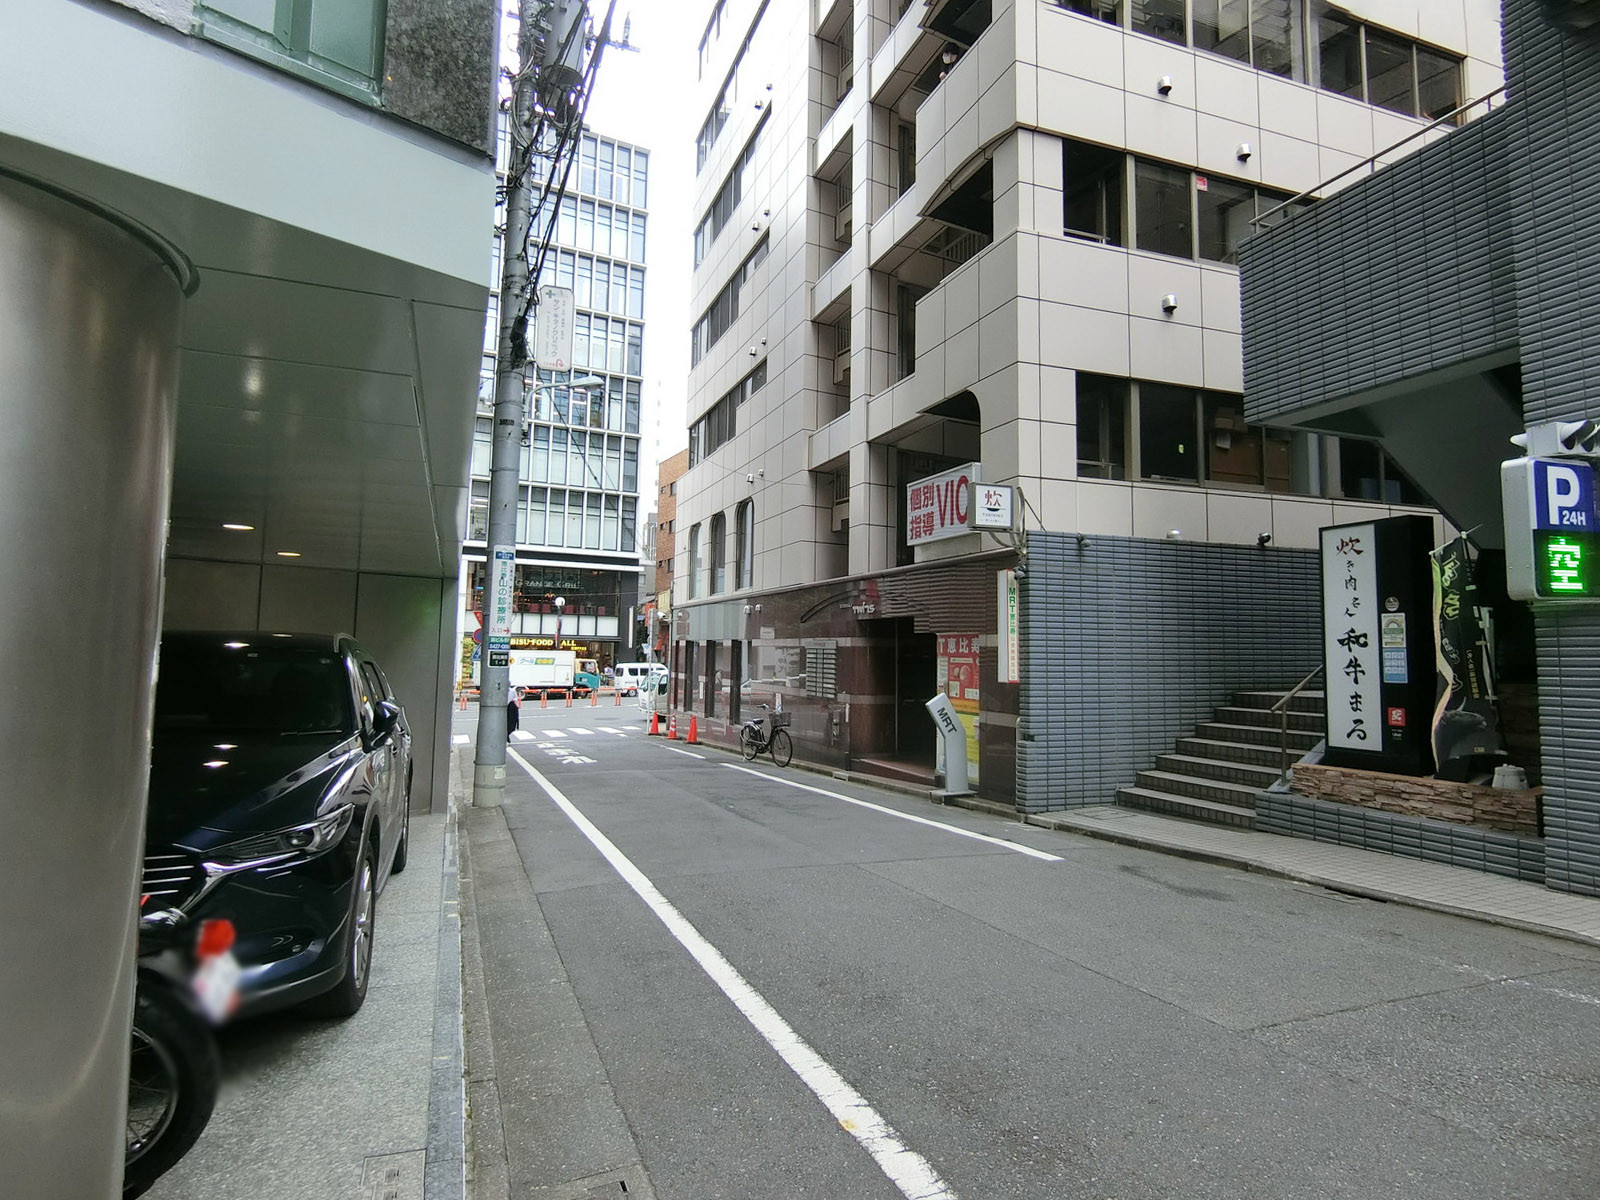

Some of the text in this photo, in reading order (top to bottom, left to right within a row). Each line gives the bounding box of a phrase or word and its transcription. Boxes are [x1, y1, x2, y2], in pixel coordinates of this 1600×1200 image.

[910, 482, 935, 513] 個別
[936, 475, 970, 528] VIC
[1547, 465, 1580, 525] P
[910, 511, 935, 541] 指導
[1562, 511, 1586, 525] 24H
[1548, 537, 1583, 590] 空
[937, 706, 958, 734] MRT
